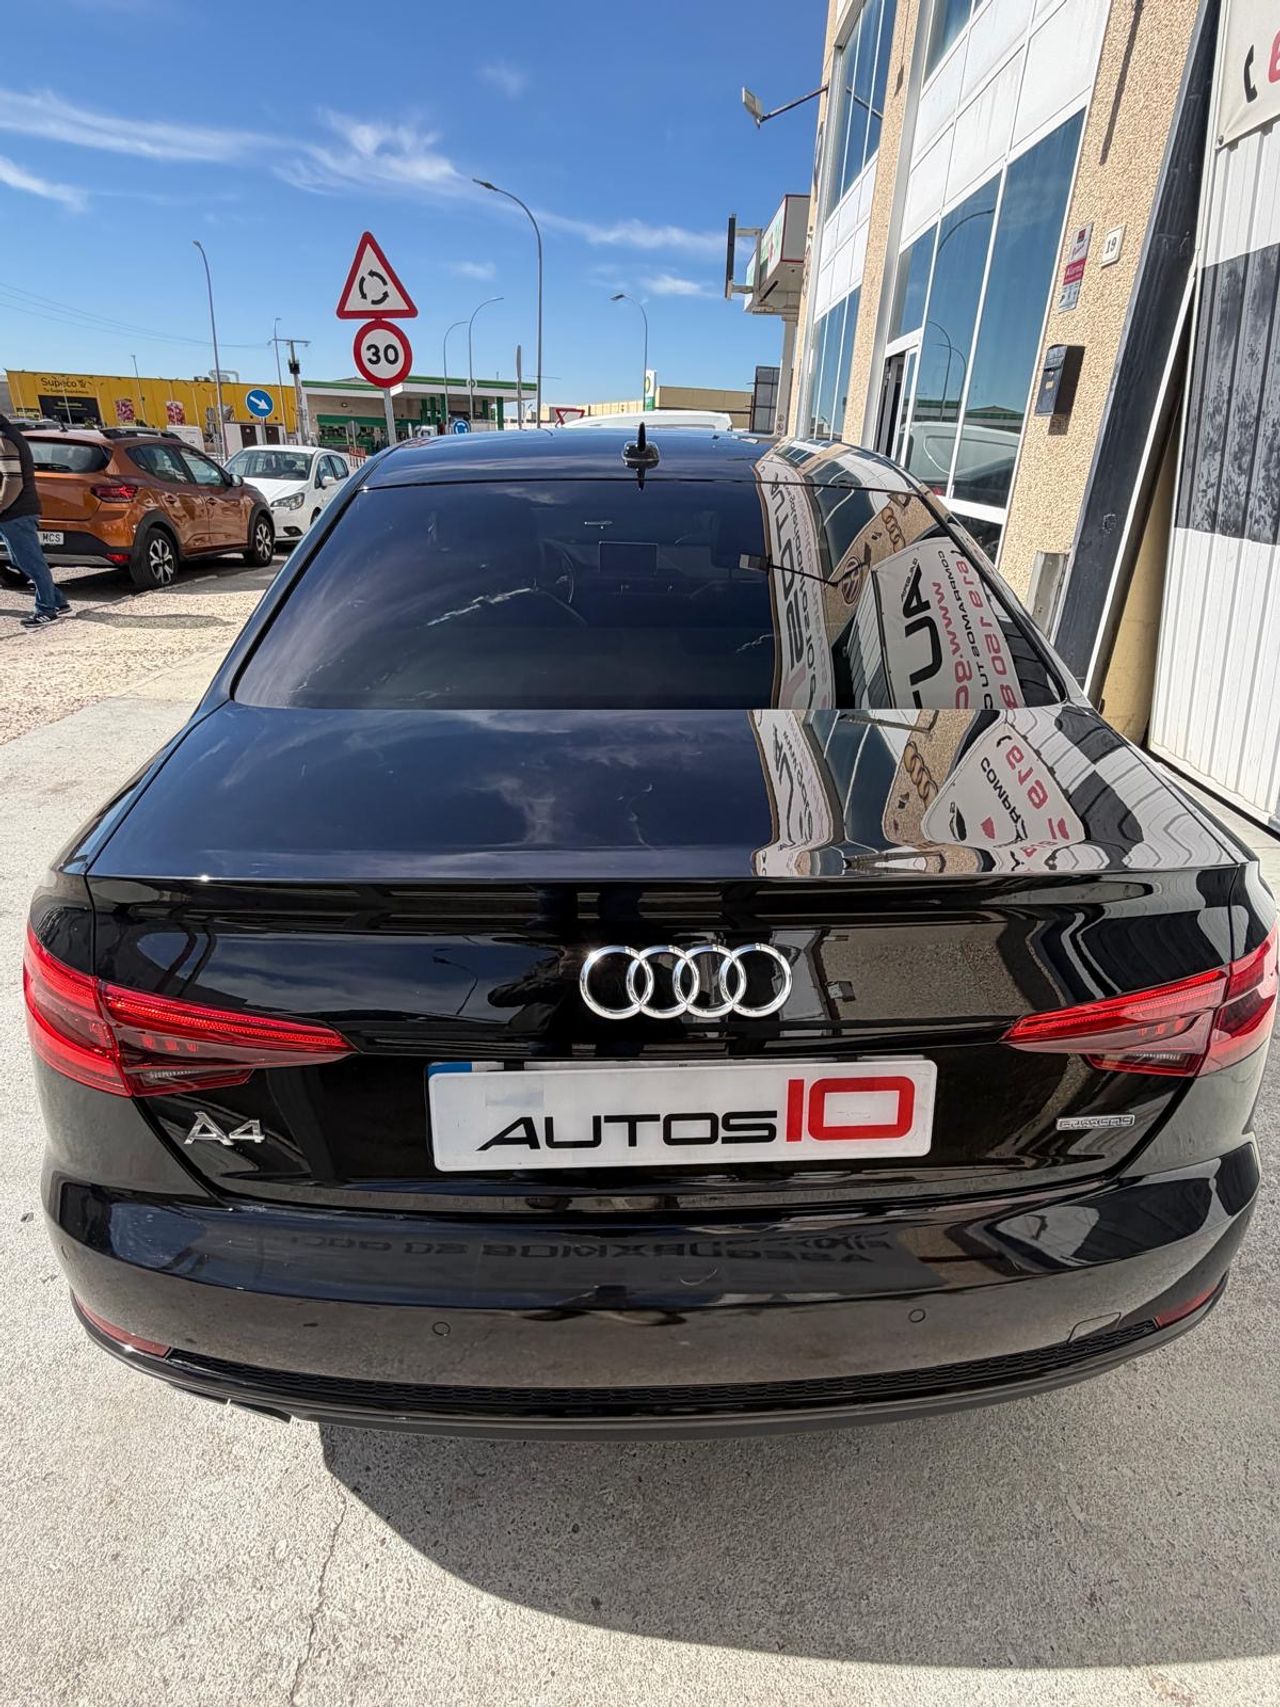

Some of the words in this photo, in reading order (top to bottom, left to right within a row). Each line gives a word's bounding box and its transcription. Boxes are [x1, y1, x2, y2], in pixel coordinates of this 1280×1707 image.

[1105, 236, 1118, 254] 19
[366, 344, 399, 365] 30
[42, 532, 61, 543] MCS
[184, 1110, 265, 1145] A4
